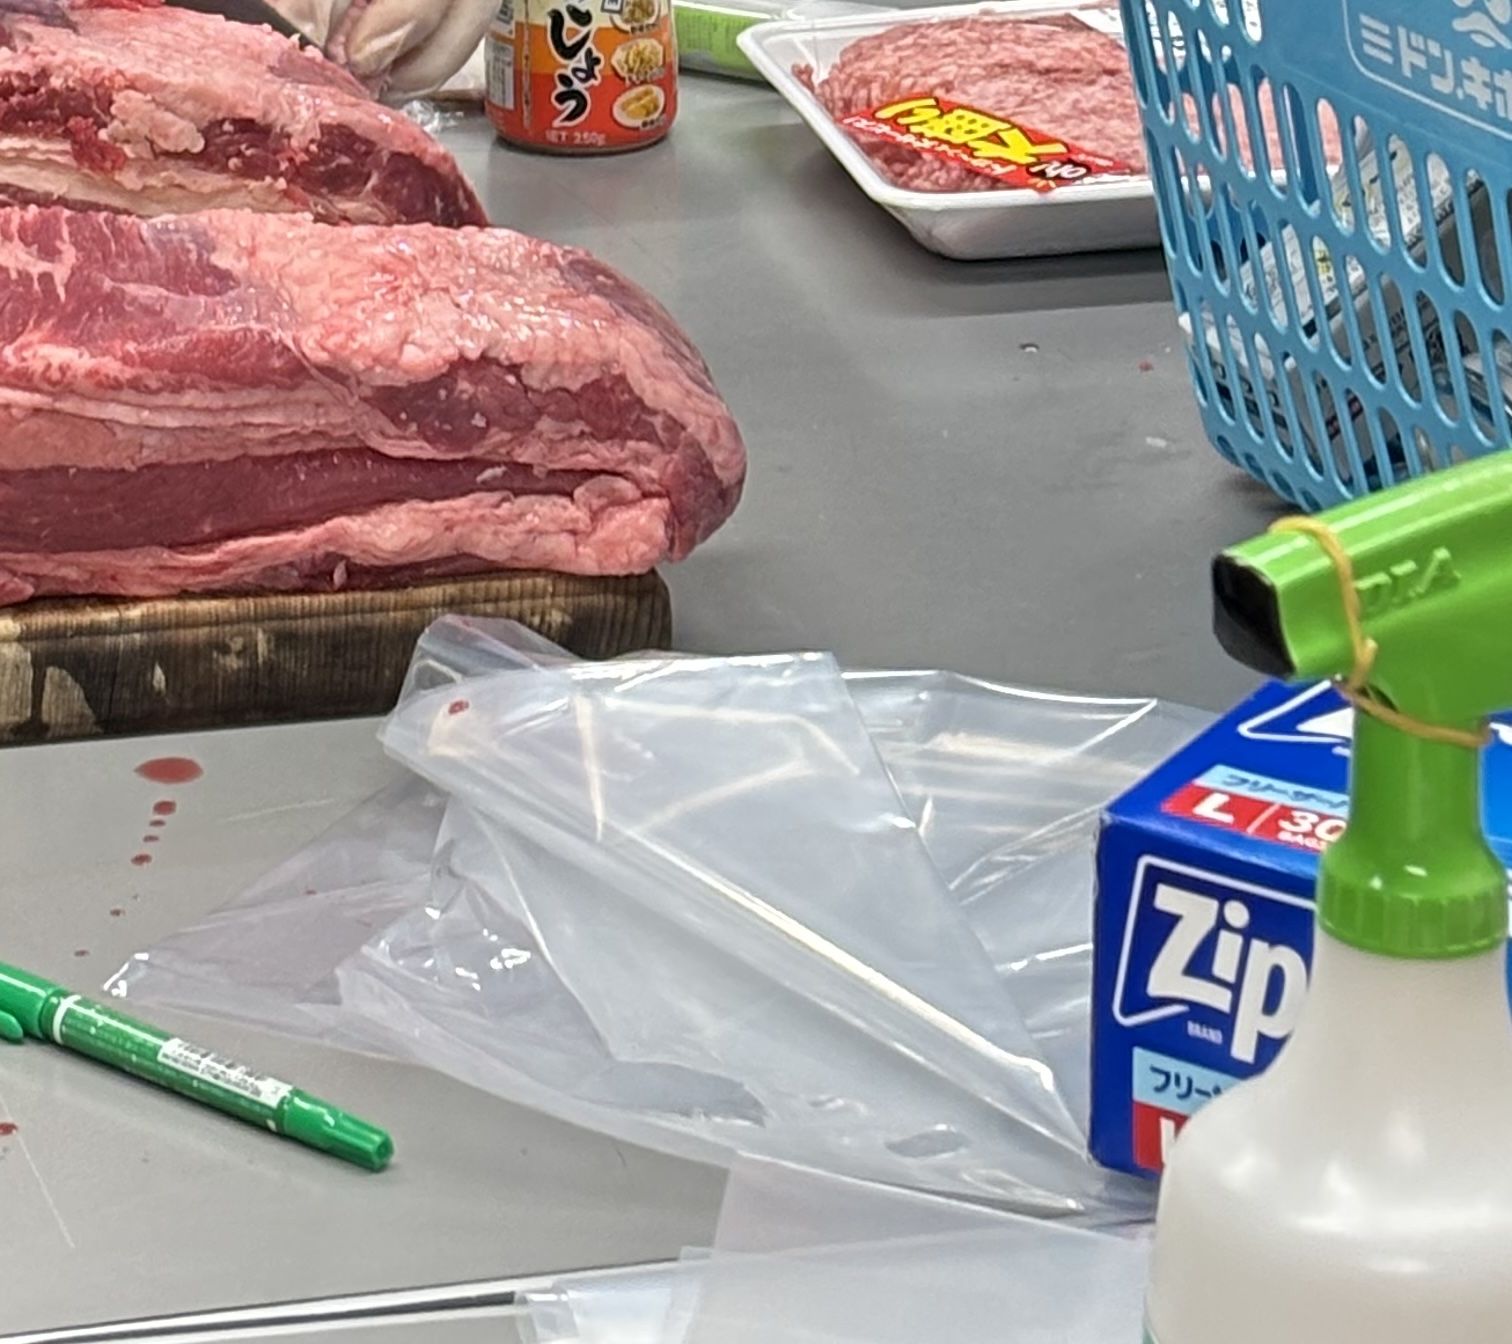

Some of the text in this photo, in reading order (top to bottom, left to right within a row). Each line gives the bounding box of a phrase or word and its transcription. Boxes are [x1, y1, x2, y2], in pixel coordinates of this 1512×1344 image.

[1192, 792, 1347, 843] L 30
[1147, 883, 1307, 1064] Zip
[1187, 1020, 1223, 1045] BRAND
[1149, 1064, 1221, 1101] フリー
